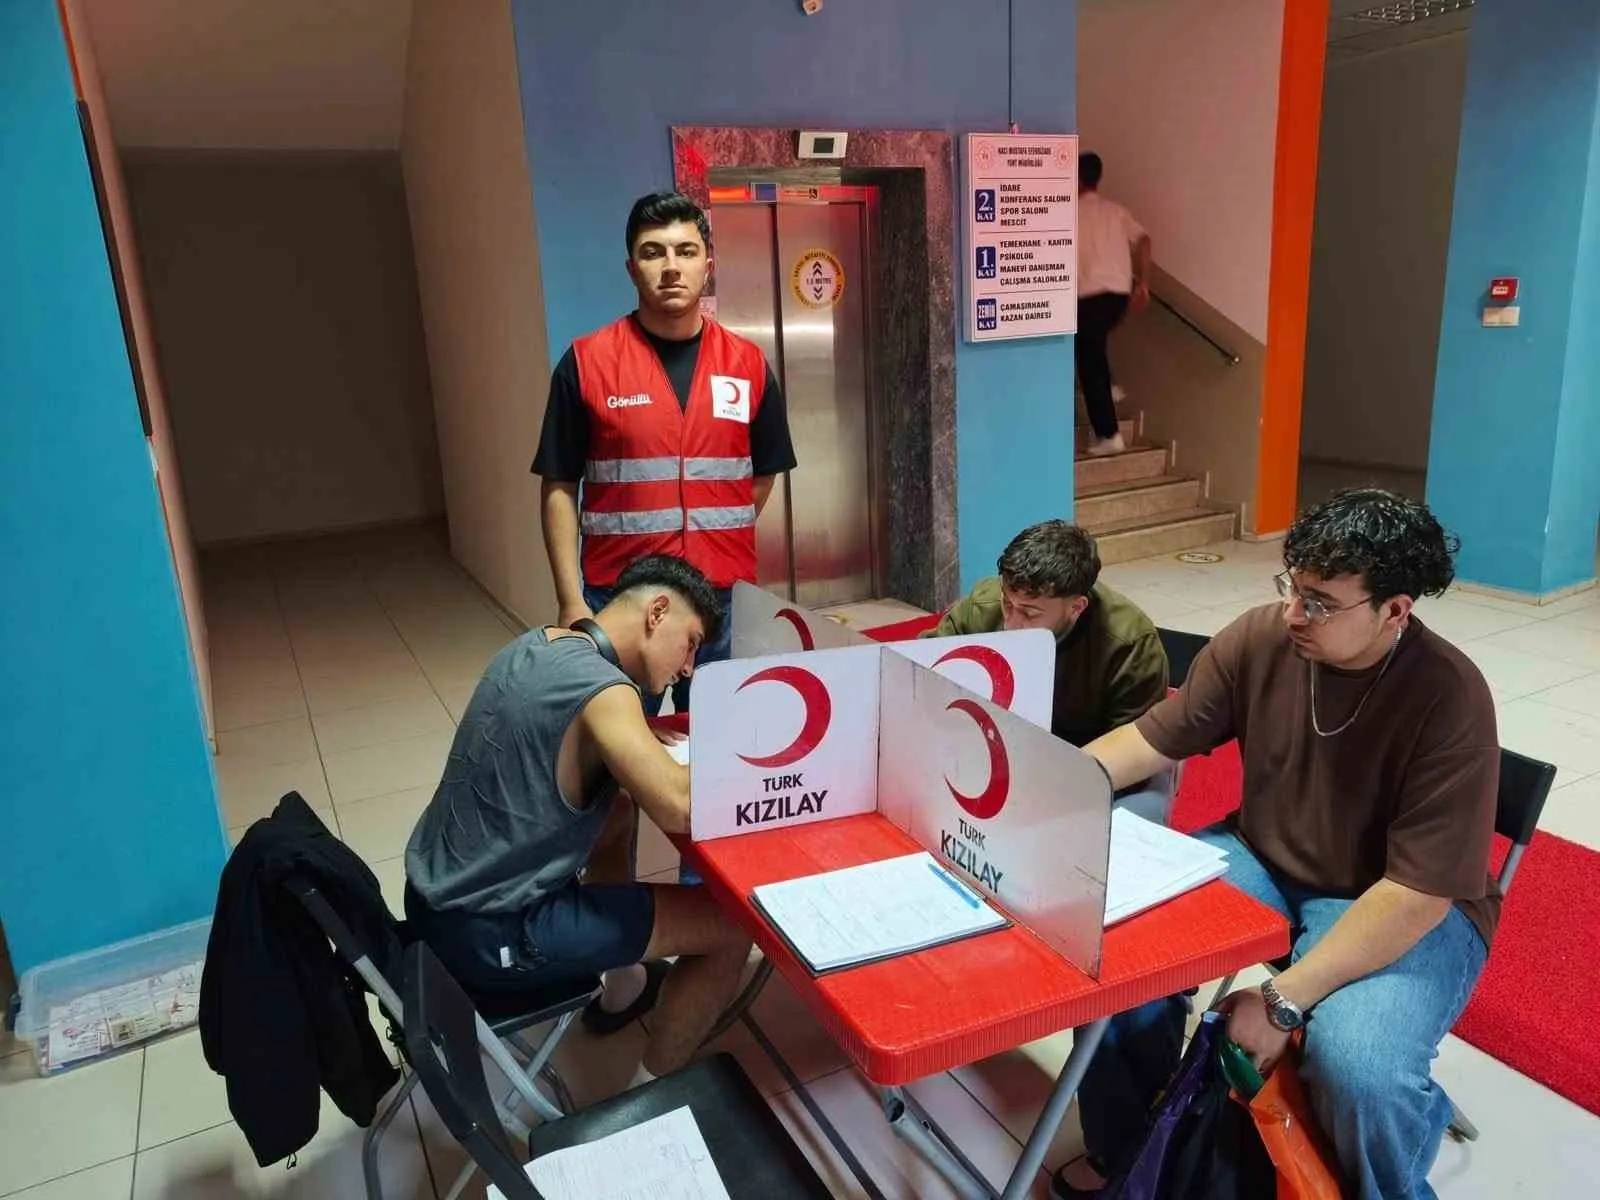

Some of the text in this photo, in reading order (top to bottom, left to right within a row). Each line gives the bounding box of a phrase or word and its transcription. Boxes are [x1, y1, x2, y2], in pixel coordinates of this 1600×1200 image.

[1000, 195, 1071, 204] KONFERANS SALONU
[1000, 206, 1049, 215] SPOR SALONU
[976, 212, 994, 221] KAT
[1000, 239, 1042, 248] YEMEKHANE
[1000, 252, 1034, 260] PSİKOLOG
[1000, 264, 1027, 273] MANEVİ
[977, 269, 995, 278] KAT
[1033, 275, 1070, 284] SALONLARI
[1000, 314, 1023, 322] KAZAN
[978, 320, 996, 329] KAT
[762, 773, 804, 793] TÜRK
[736, 790, 829, 827] KIZILAY
[958, 817, 986, 851] TÜRK
[941, 829, 1004, 893] KIZILAY
